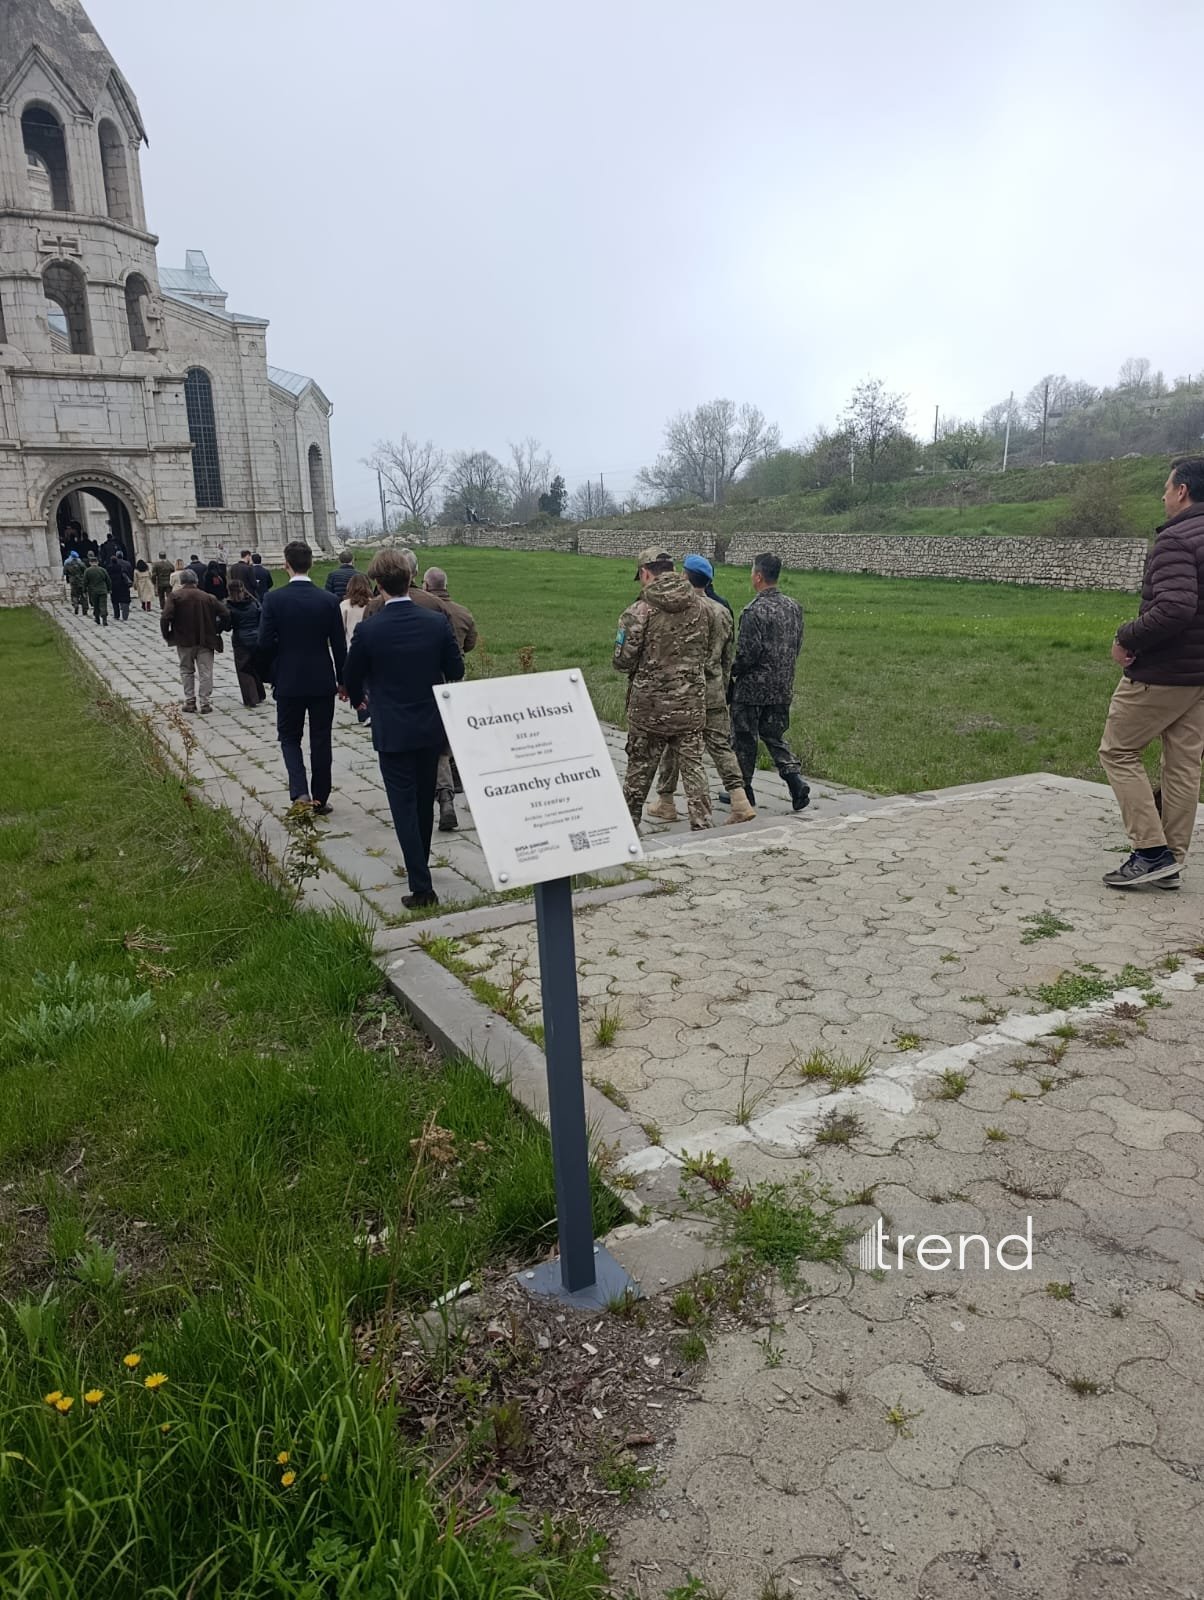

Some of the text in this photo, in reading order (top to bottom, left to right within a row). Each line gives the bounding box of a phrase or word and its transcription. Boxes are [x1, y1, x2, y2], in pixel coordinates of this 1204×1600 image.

[466, 702, 574, 730] Qazançı kilsəsi
[484, 767, 601, 798] Gazanchy church
